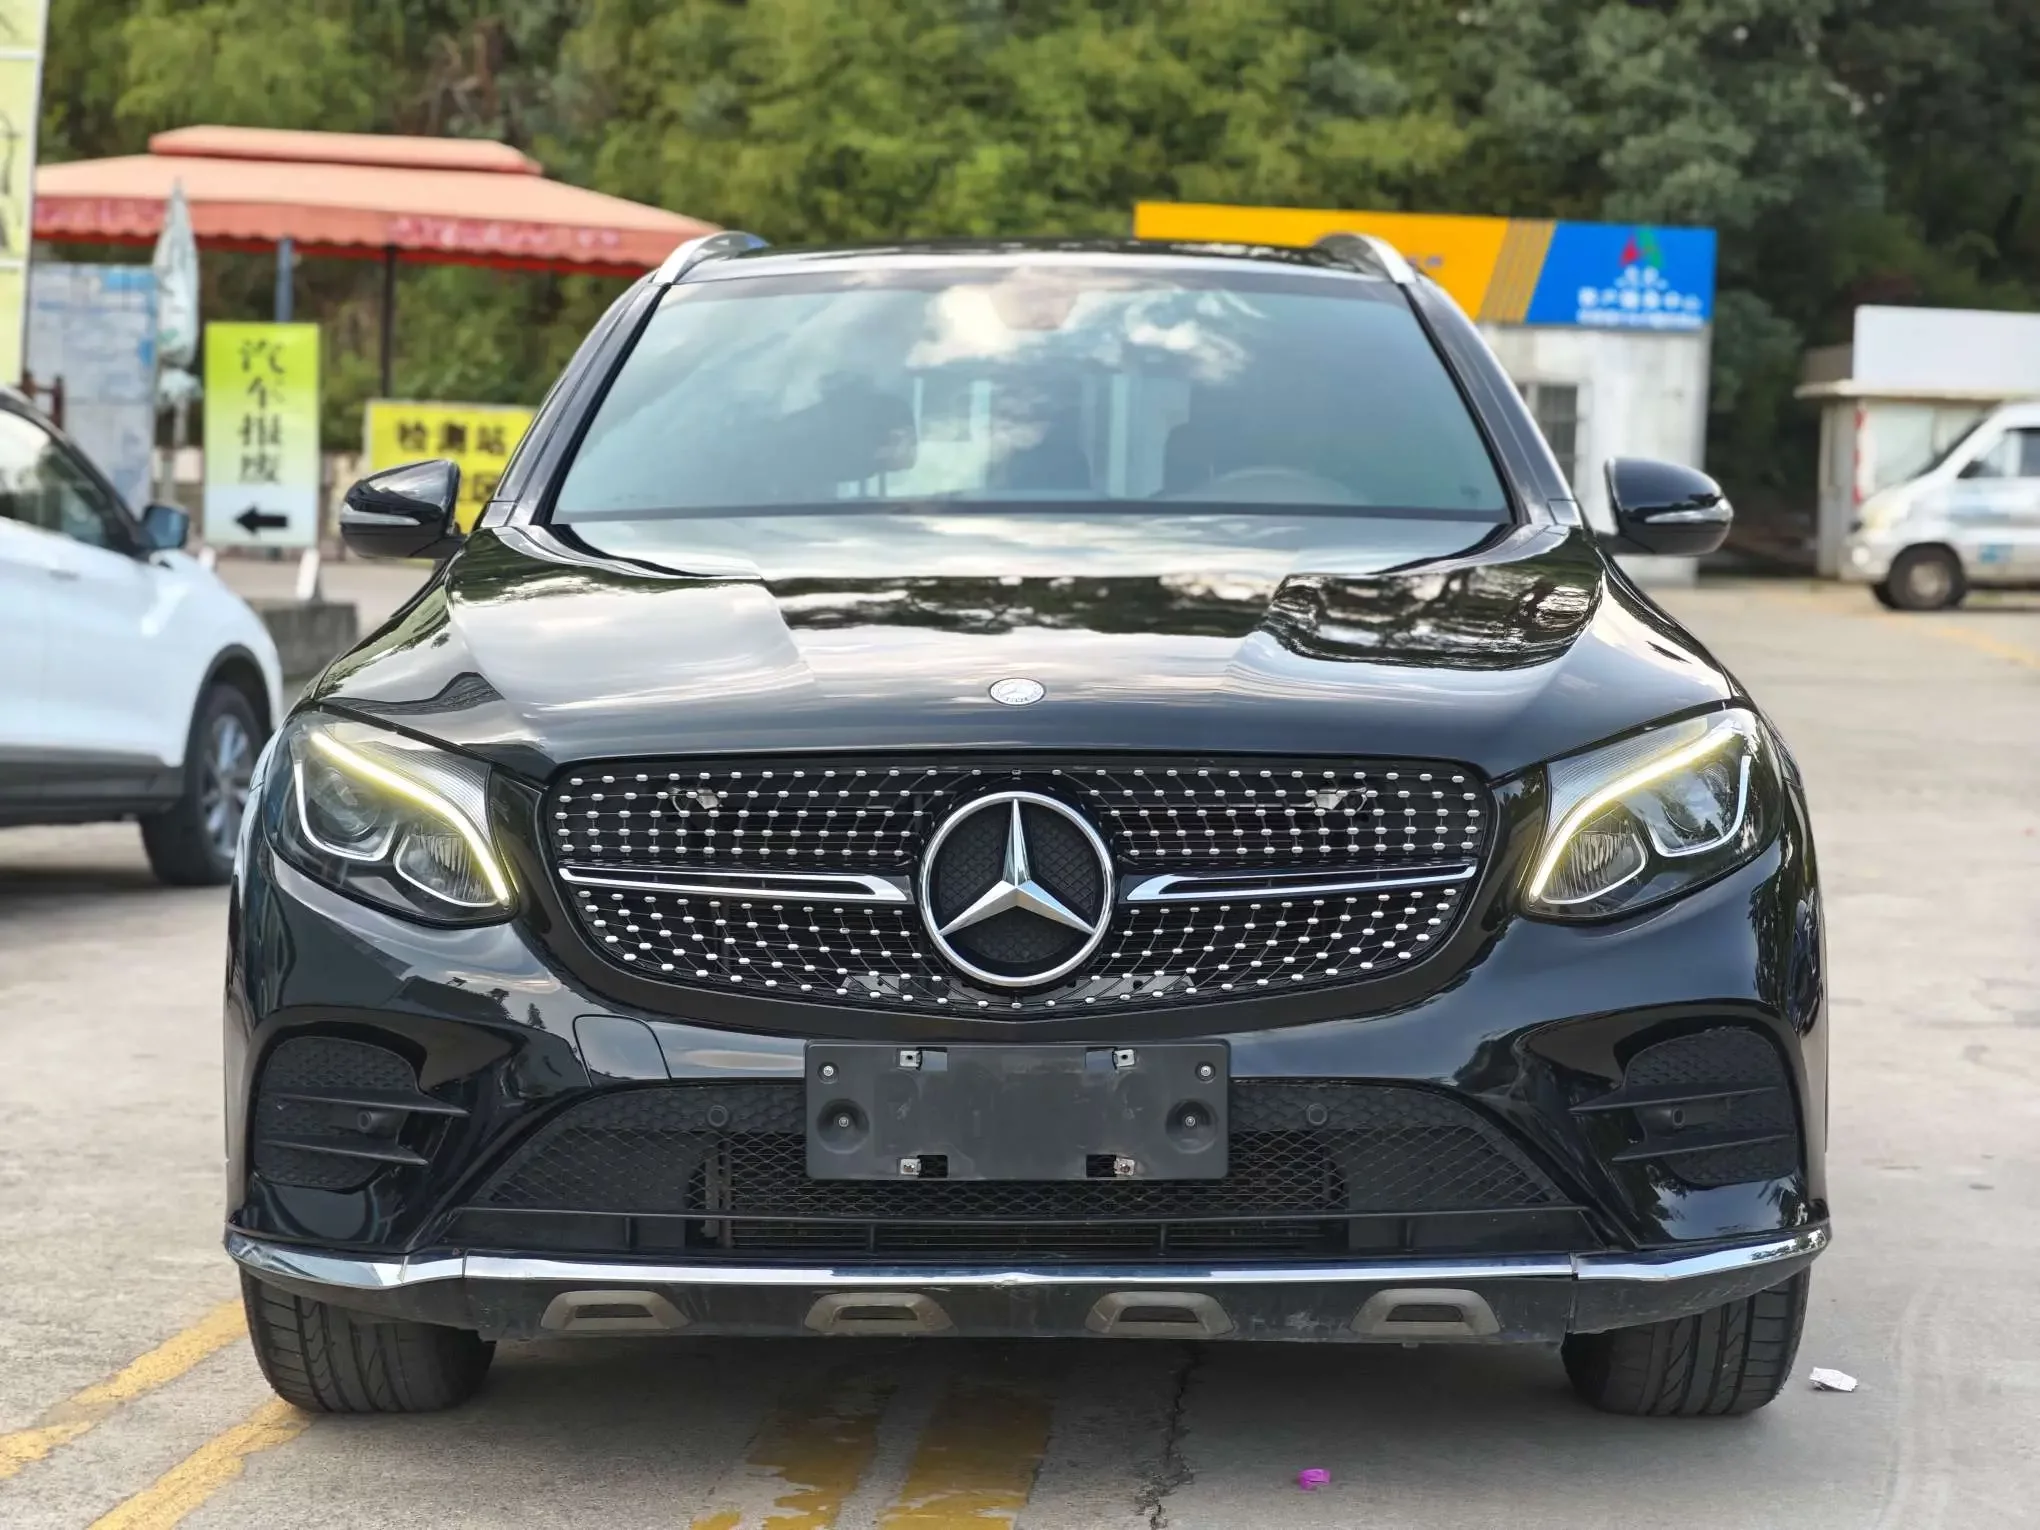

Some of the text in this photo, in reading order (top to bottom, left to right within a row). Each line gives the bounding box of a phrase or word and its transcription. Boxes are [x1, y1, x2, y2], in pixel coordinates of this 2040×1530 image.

[238, 338, 287, 484] 汽车报废
[396, 418, 507, 455] 检测站
